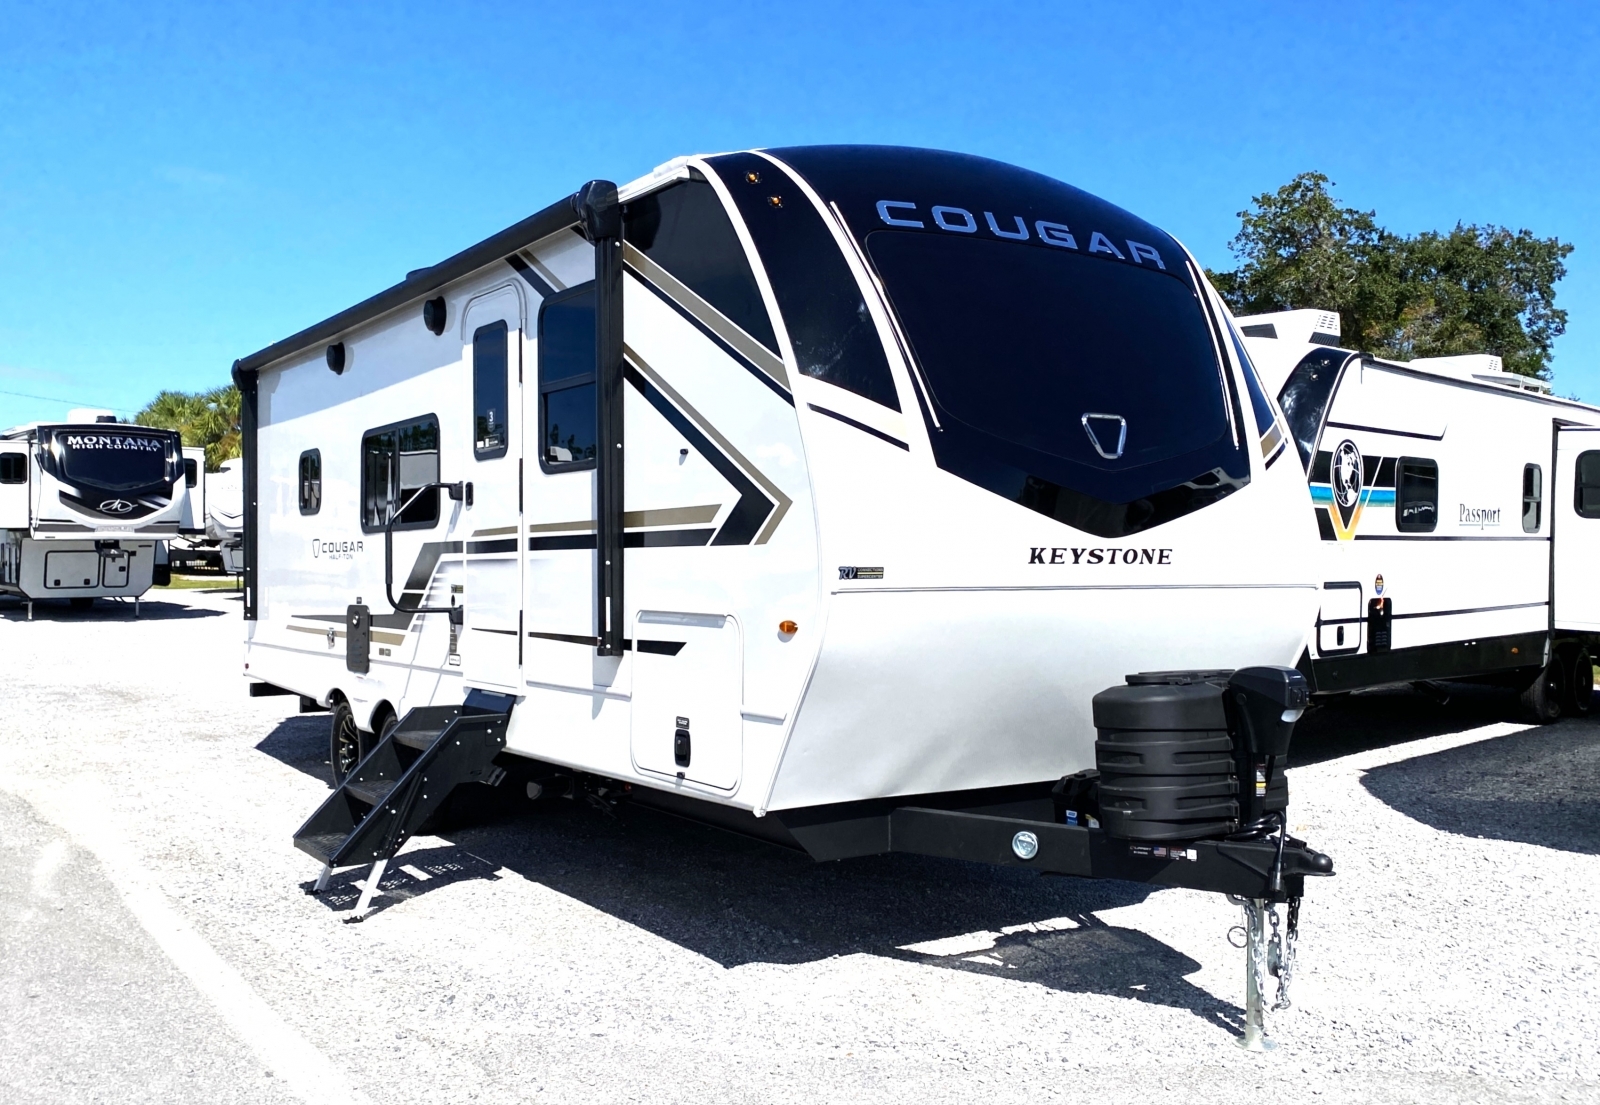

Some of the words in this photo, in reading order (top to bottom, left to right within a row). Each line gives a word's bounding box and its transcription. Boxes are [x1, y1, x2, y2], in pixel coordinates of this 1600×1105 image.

[876, 200, 1167, 270] COUGAR
[67, 436, 162, 448] MONTANA
[107, 444, 158, 452] COUNTRY
[1459, 504, 1501, 530] Passport
[322, 541, 364, 553] COUGAR
[1028, 547, 1173, 565] KEYSTONE
[838, 566, 857, 580] RV
